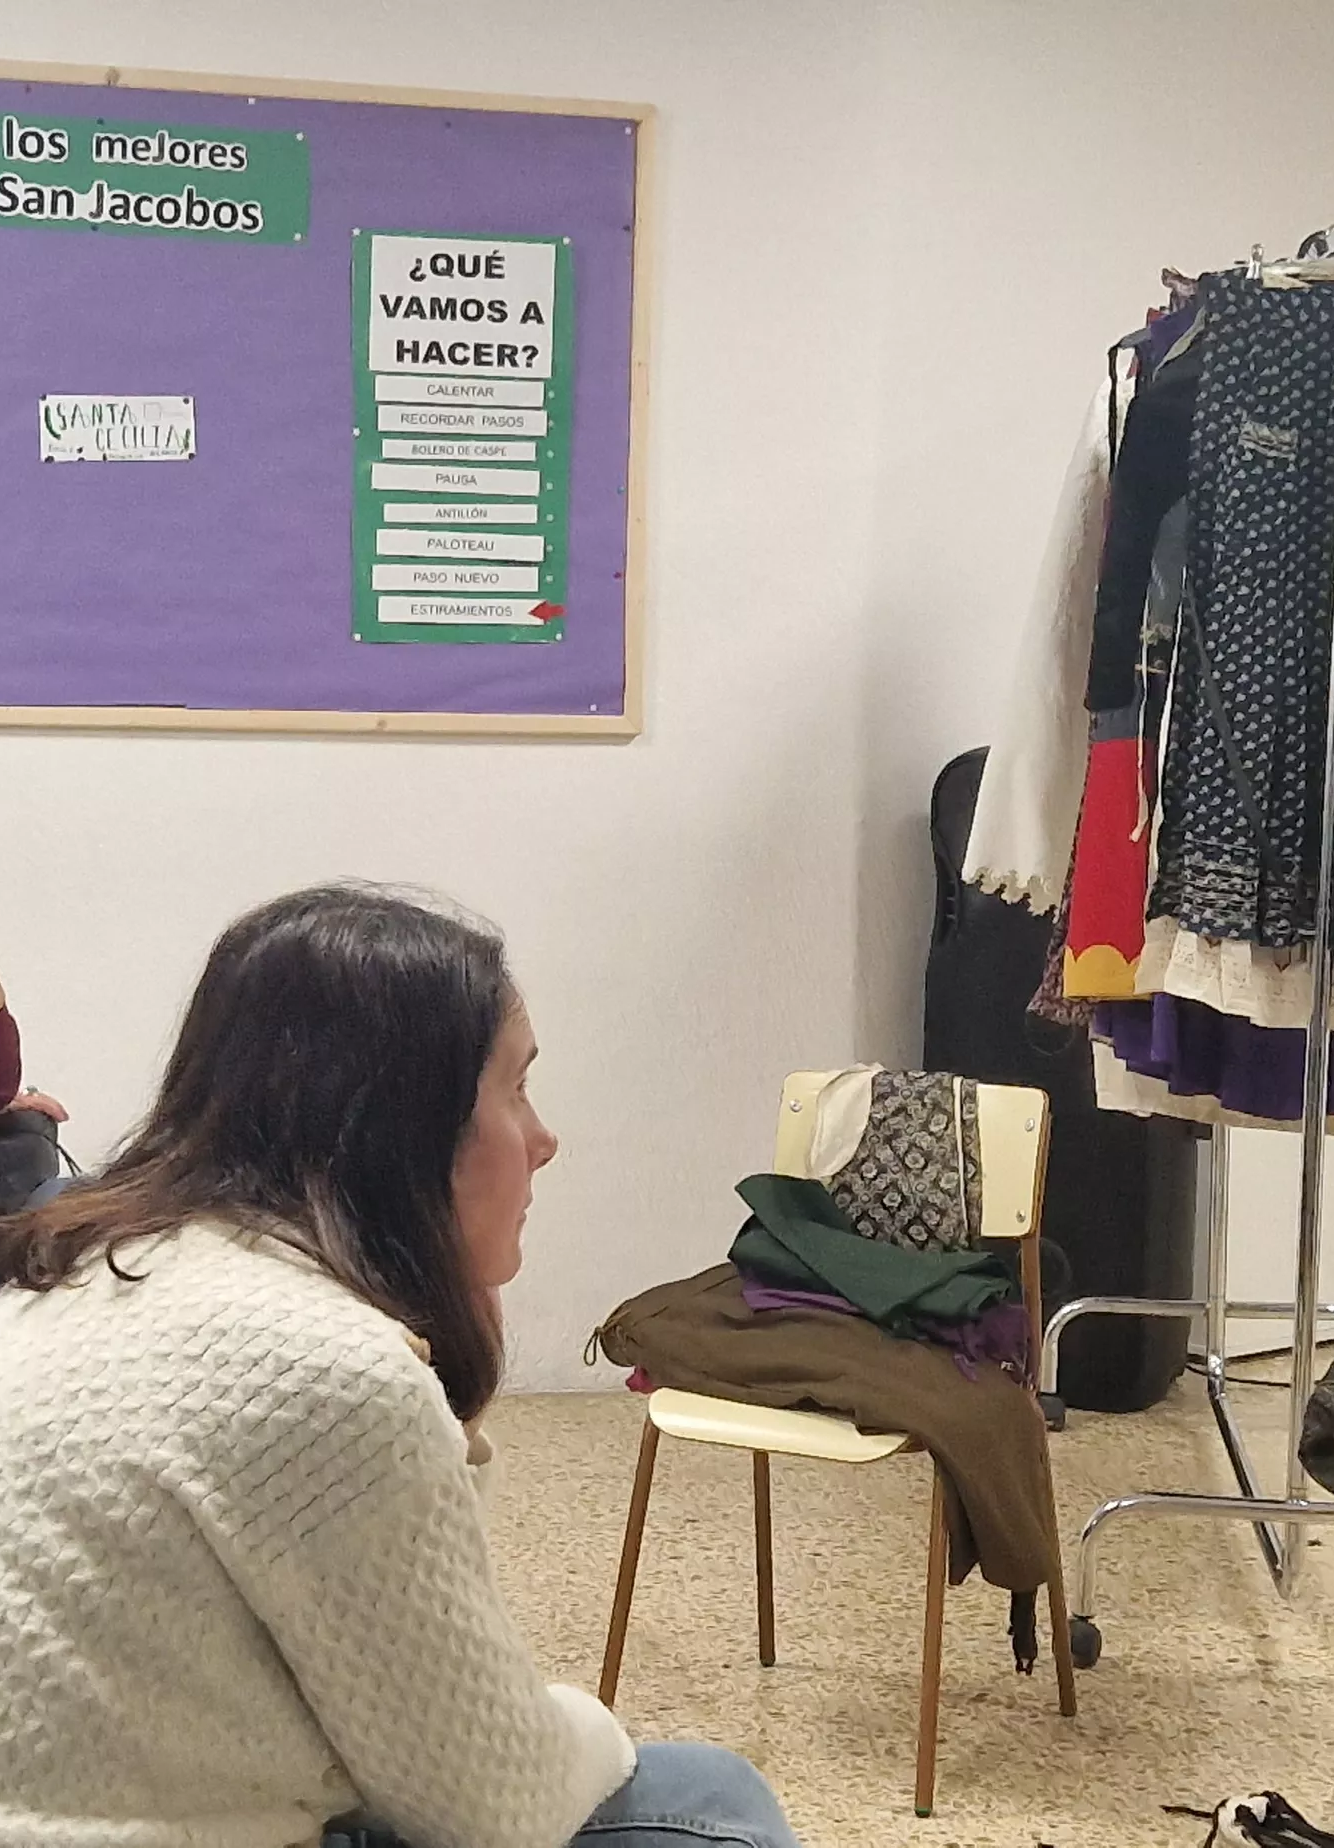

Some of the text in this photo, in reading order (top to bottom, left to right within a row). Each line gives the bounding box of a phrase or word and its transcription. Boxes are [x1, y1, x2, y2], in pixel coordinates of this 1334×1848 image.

[6, 118, 66, 160] los
[88, 183, 261, 230] Jacobos
[408, 249, 506, 282] ¿QUÉ
[379, 294, 545, 325] VAMOS A
[396, 339, 540, 368] HACER?
[427, 384, 495, 398] CALENTAR
[56, 402, 137, 430] SANTA
[401, 413, 525, 428] RECORDAR PASOS
[96, 425, 185, 449] CECILIA
[411, 444, 507, 457] BOLERO DE CASPE
[435, 473, 478, 486] PAUSA
[435, 506, 488, 519] ANTILLÓN
[427, 538, 495, 551] PALOTEAU
[413, 572, 500, 584] PASO NUEVO
[411, 604, 513, 617] ESTIRAMIENTOS
